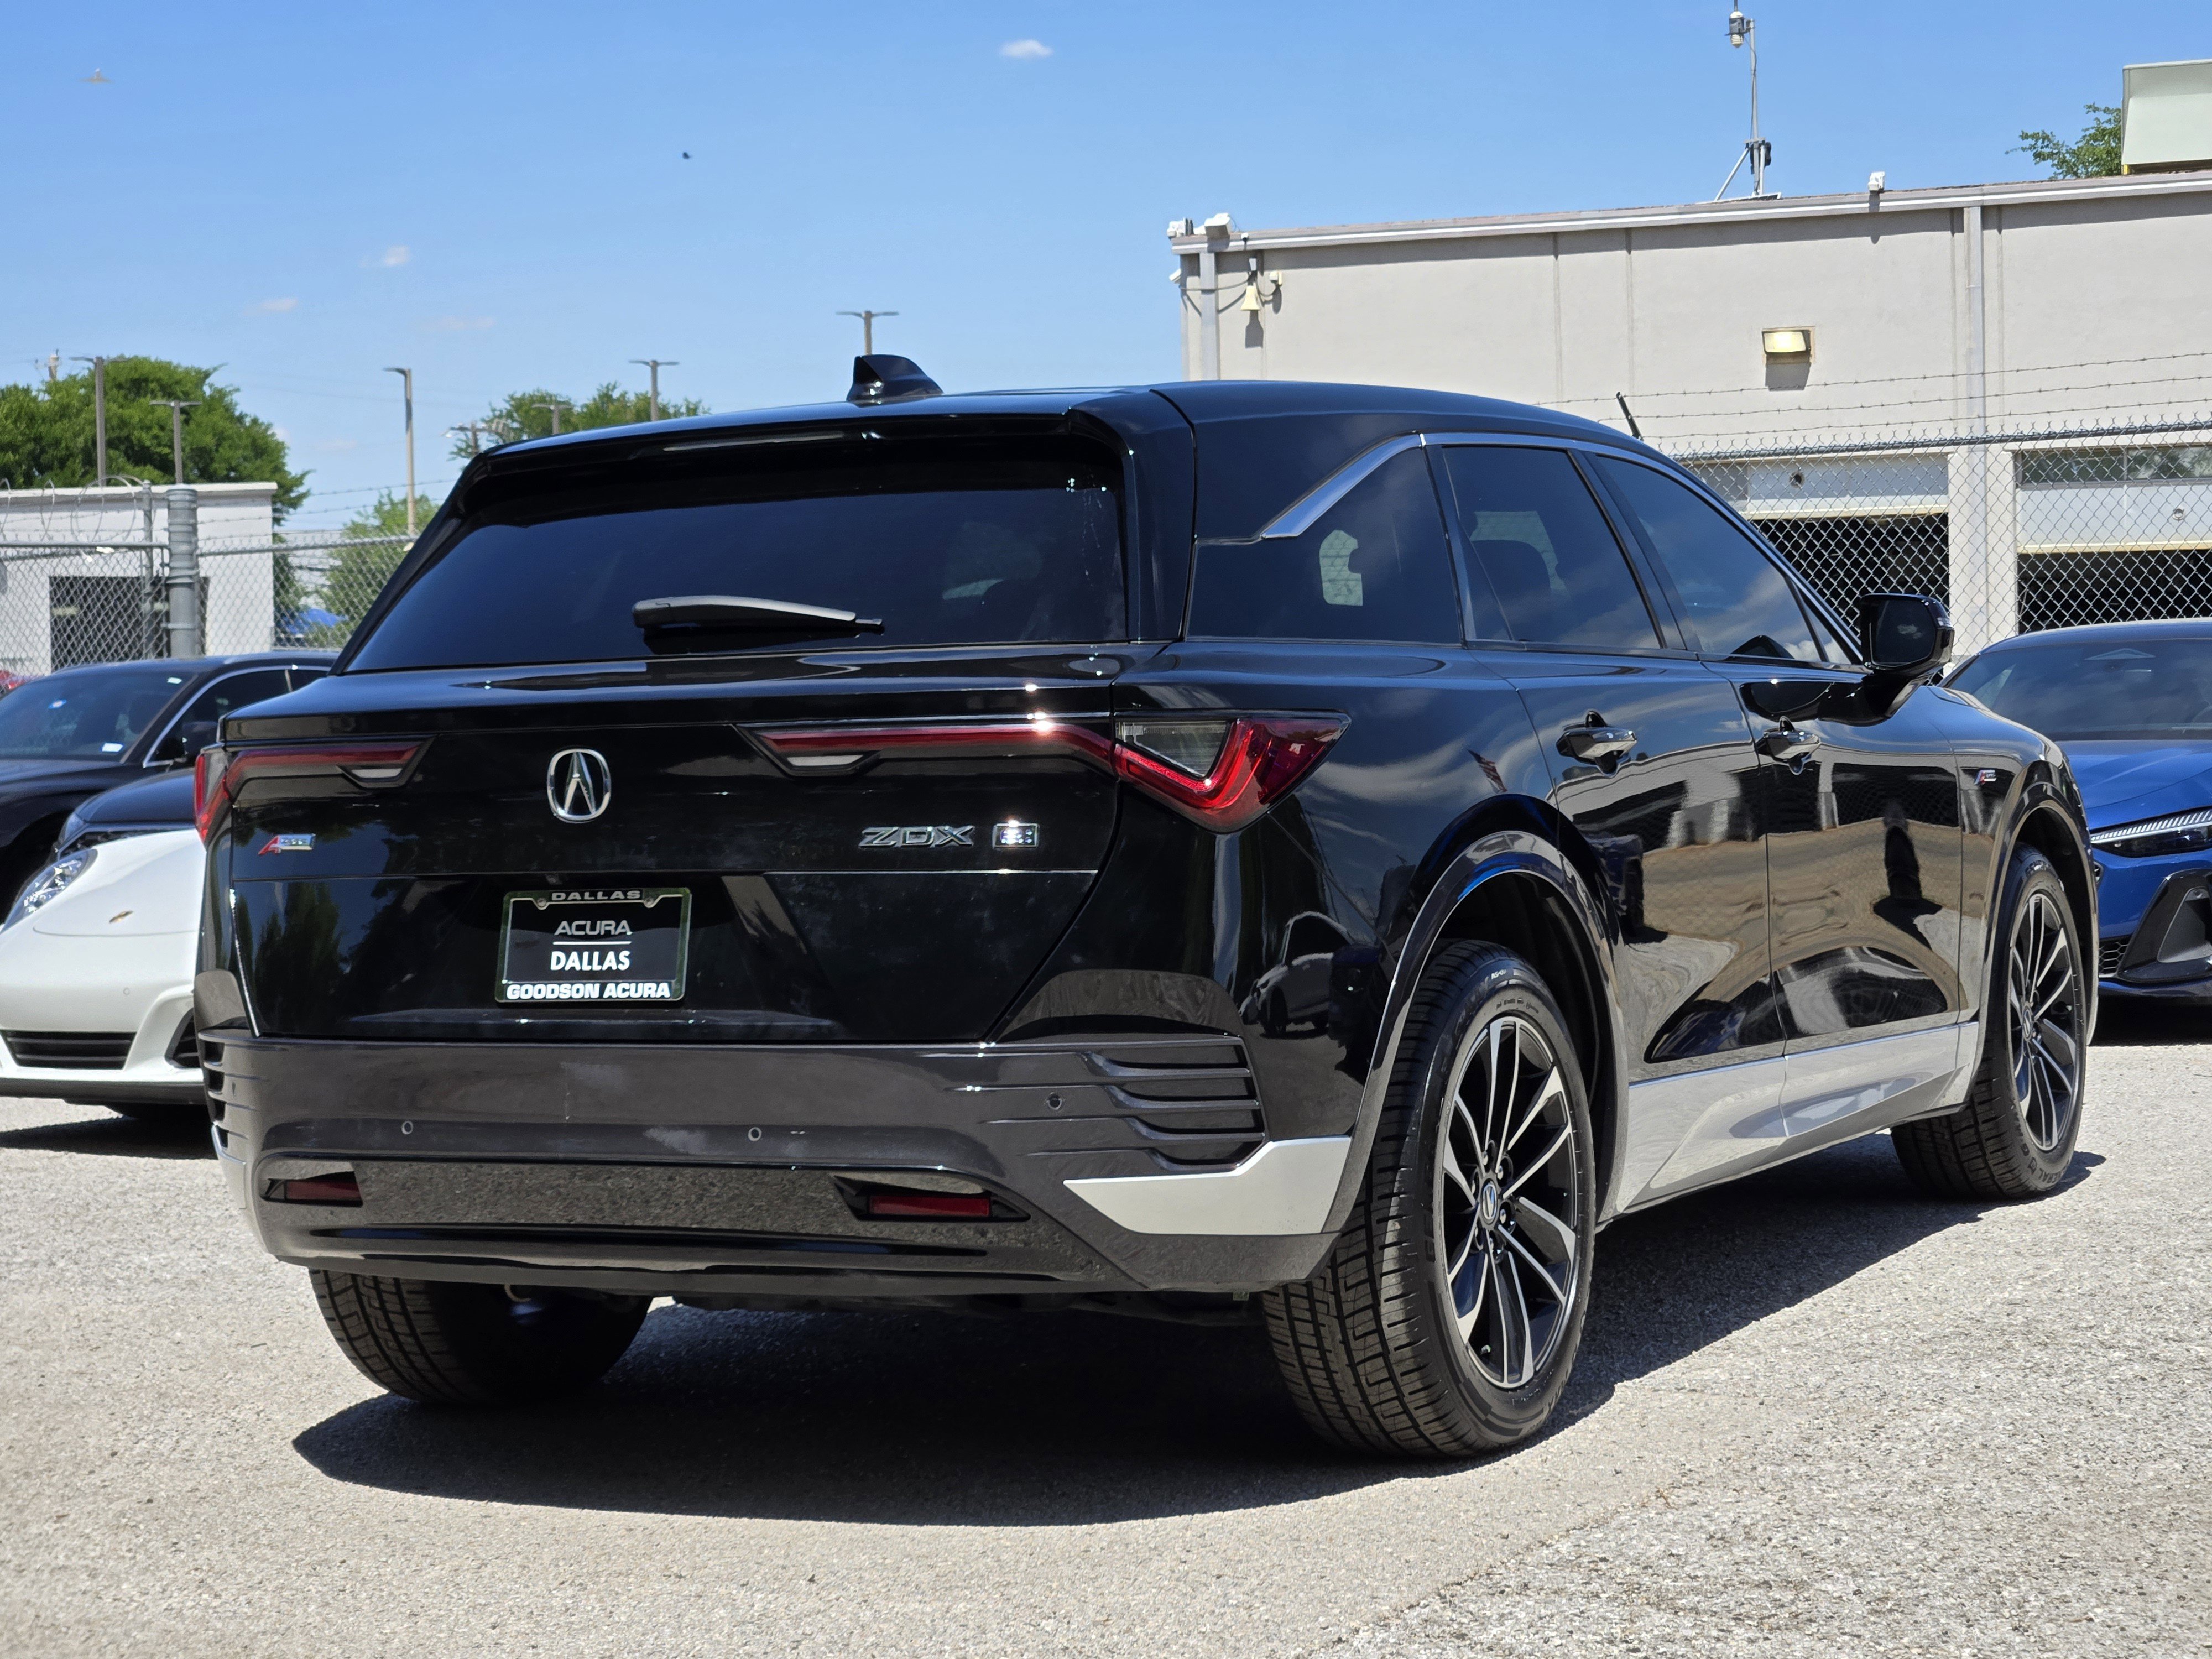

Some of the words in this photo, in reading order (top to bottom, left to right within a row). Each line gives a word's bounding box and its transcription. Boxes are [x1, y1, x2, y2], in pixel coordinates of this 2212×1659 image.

[858, 826, 975, 848] ZDX
[551, 890, 641, 901] DALLAS
[554, 920, 632, 936] ACURA
[550, 951, 631, 971] DALLAS
[506, 983, 600, 1000] GOODSON
[602, 982, 671, 999] ACURA
